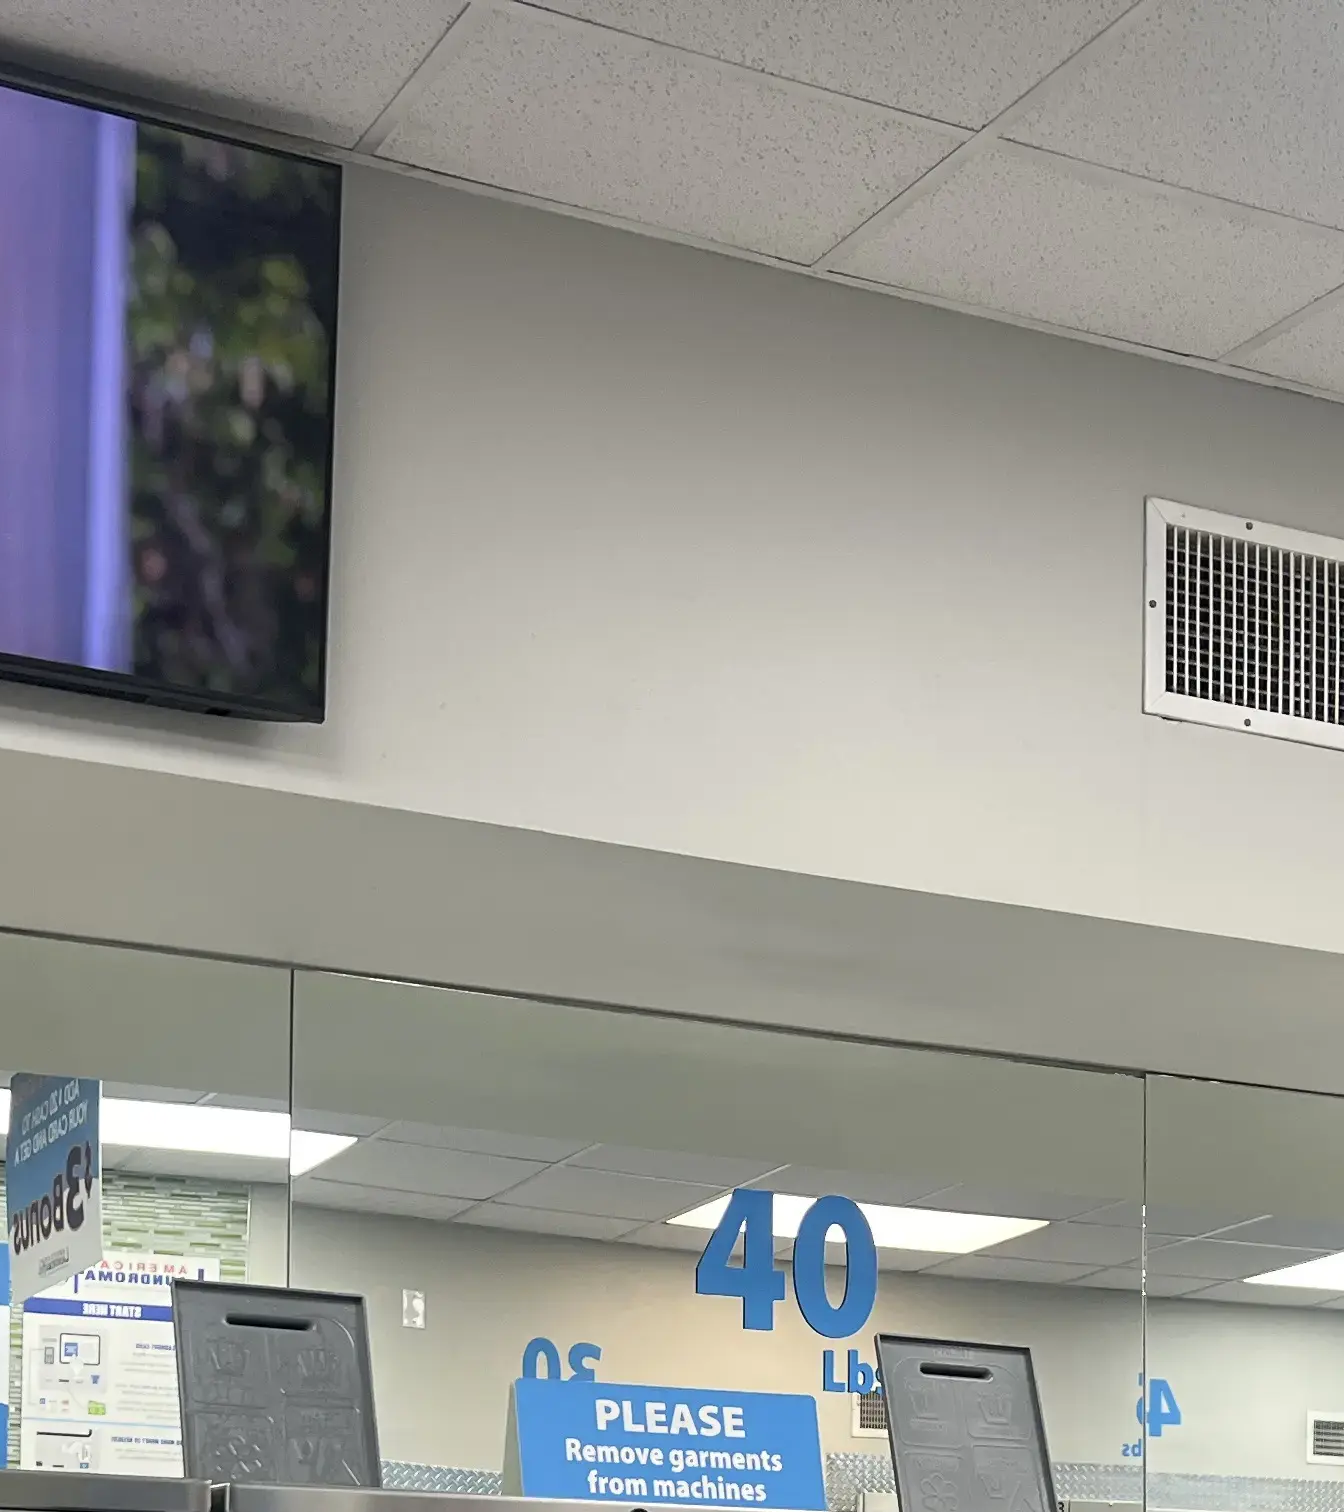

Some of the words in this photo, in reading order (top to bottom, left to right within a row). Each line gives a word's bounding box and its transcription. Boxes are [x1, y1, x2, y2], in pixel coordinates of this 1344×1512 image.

[695, 1188, 878, 1339] 40
[594, 1398, 746, 1438] PLEASE
[565, 1437, 664, 1466] Remove
[668, 1447, 783, 1473] garments
[587, 1469, 648, 1496] from
[652, 1474, 767, 1502] machines
